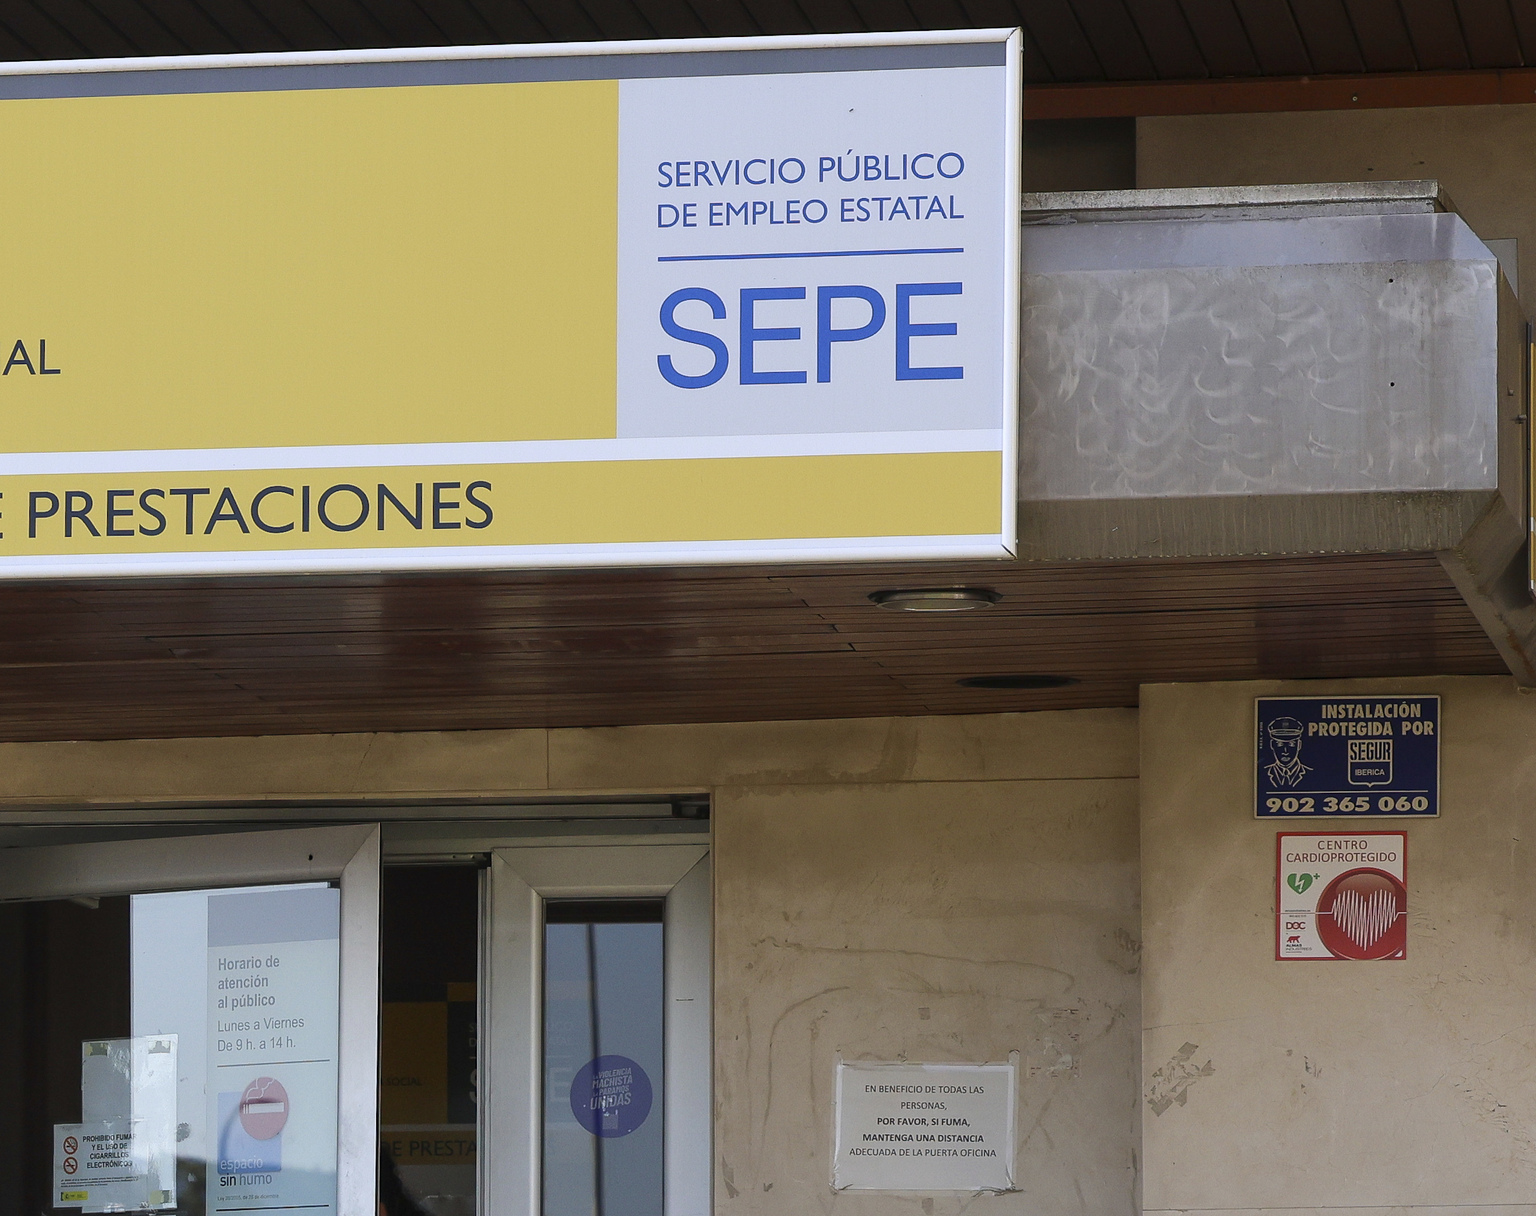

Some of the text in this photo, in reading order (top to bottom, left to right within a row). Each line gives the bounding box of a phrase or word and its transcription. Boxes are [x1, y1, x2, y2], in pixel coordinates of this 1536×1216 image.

[658, 149, 965, 187] SERVICIO PÚBLICO
[657, 195, 965, 228] DE EMPLEO ESTATAL
[657, 282, 964, 389] SEPE
[28, 480, 494, 538] PRESTACIONES
[1321, 701, 1421, 719] INSTALACIÓN
[1308, 720, 1434, 736] PROTEGIDA POR
[1349, 740, 1392, 761] SEGUR
[1354, 768, 1386, 776] IBERICA
[1265, 795, 1429, 813] 902 365 060
[1317, 839, 1369, 851] CENTRO
[1285, 851, 1397, 863] CARDIOPROTEGIDO
[1285, 921, 1306, 930] DOC
[218, 954, 280, 971] Horario de
[218, 974, 269, 989] atención
[218, 993, 277, 1011] al público
[217, 1017, 305, 1033] Lunes a Viernes
[217, 1035, 296, 1052] De 9 h. a 14 h.
[598, 1067, 632, 1079] VIOLENCIA
[592, 1075, 633, 1089] MACHISTA
[865, 1084, 985, 1094] EN BENEFICIO DE TODAS LAS
[599, 1085, 630, 1096] PARAMOS
[590, 1092, 632, 1110] UNIDAS
[900, 1101, 948, 1111] PERSONAS,
[876, 1117, 971, 1128] POR FAVOR, SI FUMA,
[82, 1134, 115, 1143] PROHIBIDO
[862, 1133, 985, 1143] MANTENGA UNA DISTANCIA
[119, 1142, 128, 1150] DE
[409, 1140, 476, 1157] PRESTA
[849, 1148, 997, 1158] ADECUADA DE LA PUERTA OFICINA
[89, 1151, 129, 1160] CIGARRILLOS
[86, 1160, 133, 1169] ELECTRÓNICOS
[220, 1155, 263, 1173] espacio
[219, 1173, 273, 1187] sin humo
